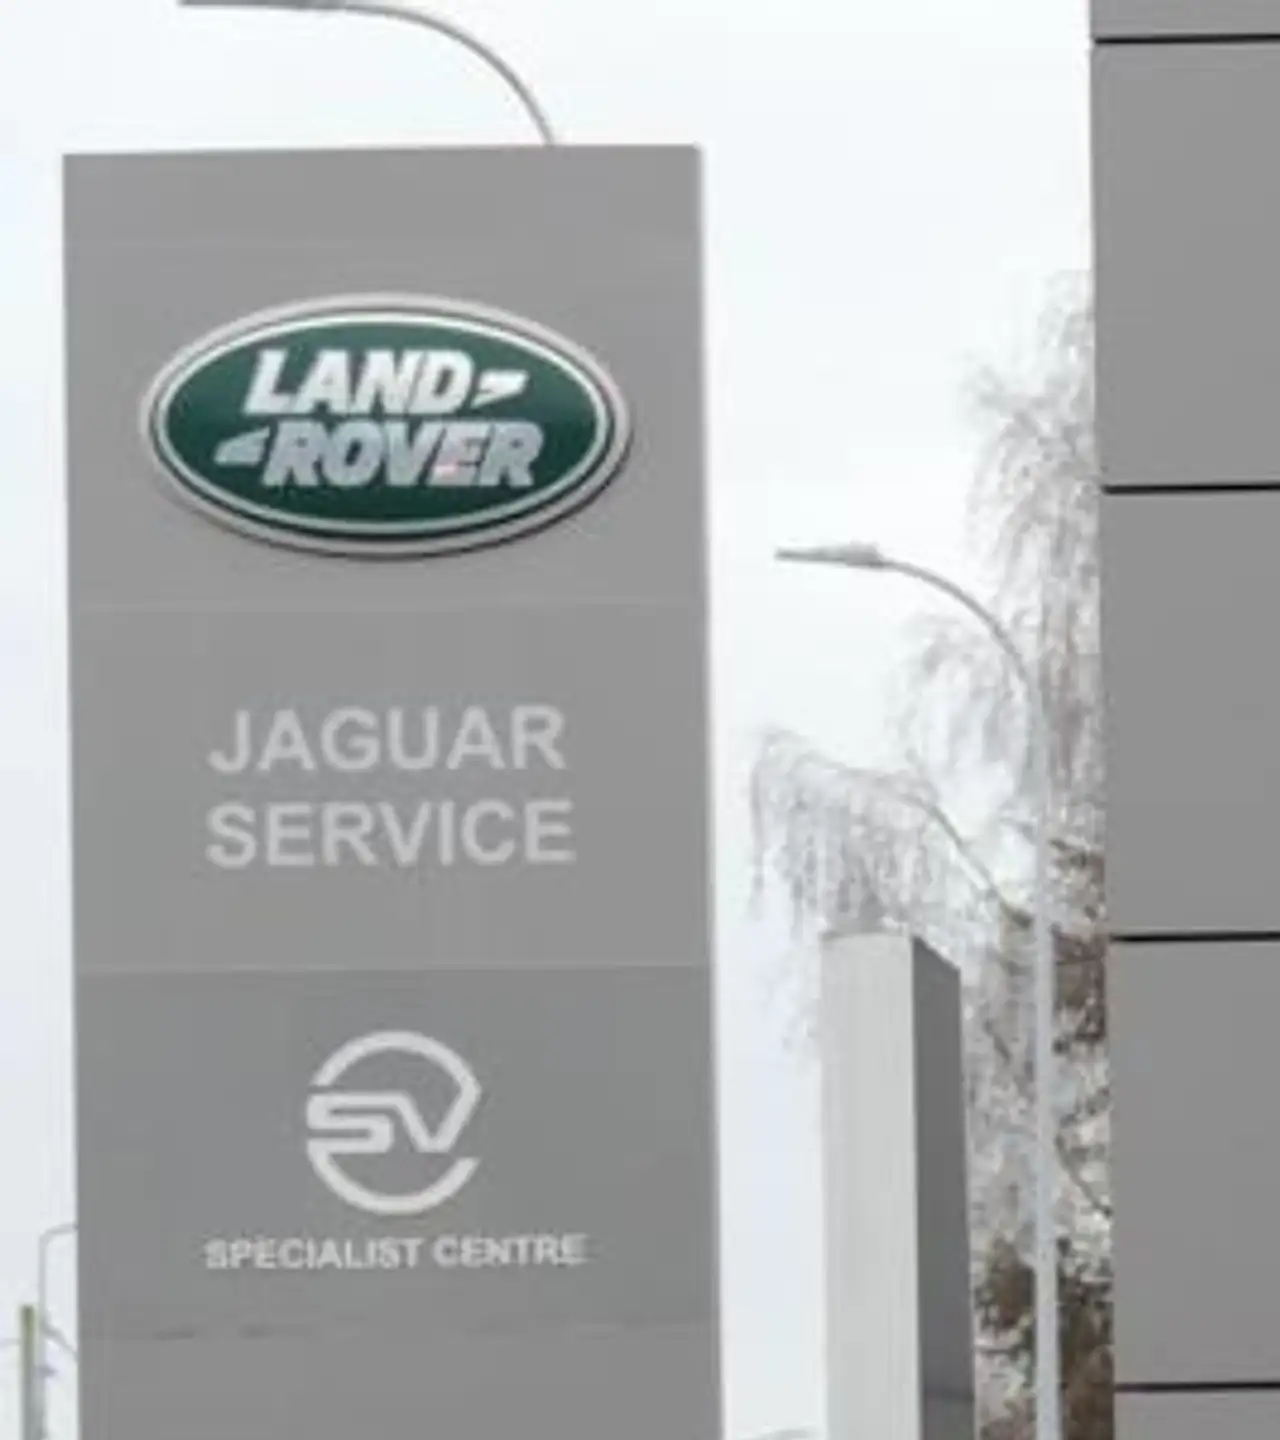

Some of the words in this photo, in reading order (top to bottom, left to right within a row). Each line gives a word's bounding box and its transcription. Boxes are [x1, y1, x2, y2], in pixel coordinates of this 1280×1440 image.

[241, 348, 476, 416] LAND
[261, 418, 546, 488] ROVER
[205, 704, 568, 774] JAGUAR
[204, 797, 578, 869] SERVICE
[203, 1236, 424, 1270] SPECIALIST
[432, 1232, 592, 1268] CENTRE
